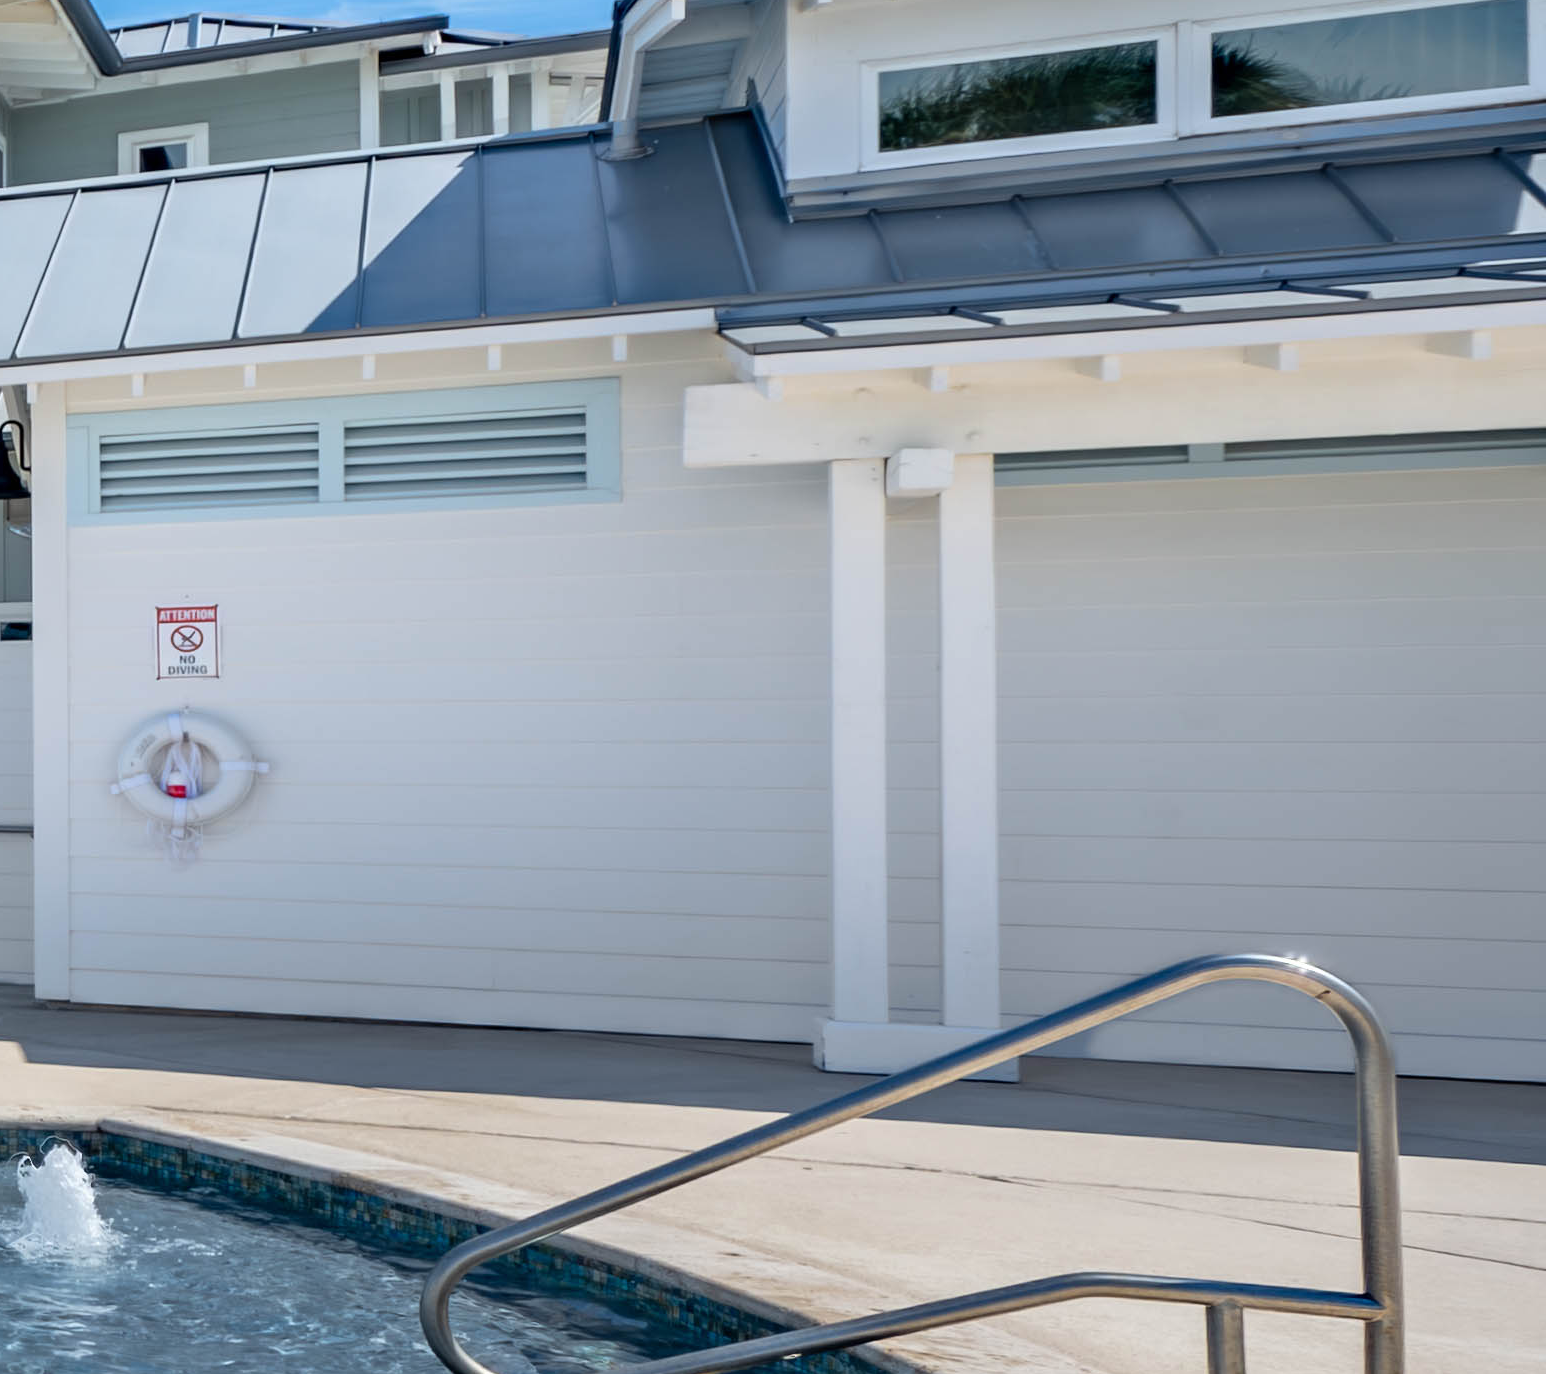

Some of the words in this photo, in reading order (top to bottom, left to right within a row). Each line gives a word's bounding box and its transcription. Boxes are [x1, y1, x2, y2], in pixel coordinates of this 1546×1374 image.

[158, 609, 215, 622] ATTENTION
[179, 655, 196, 665] NO
[167, 665, 208, 675] DIVING
